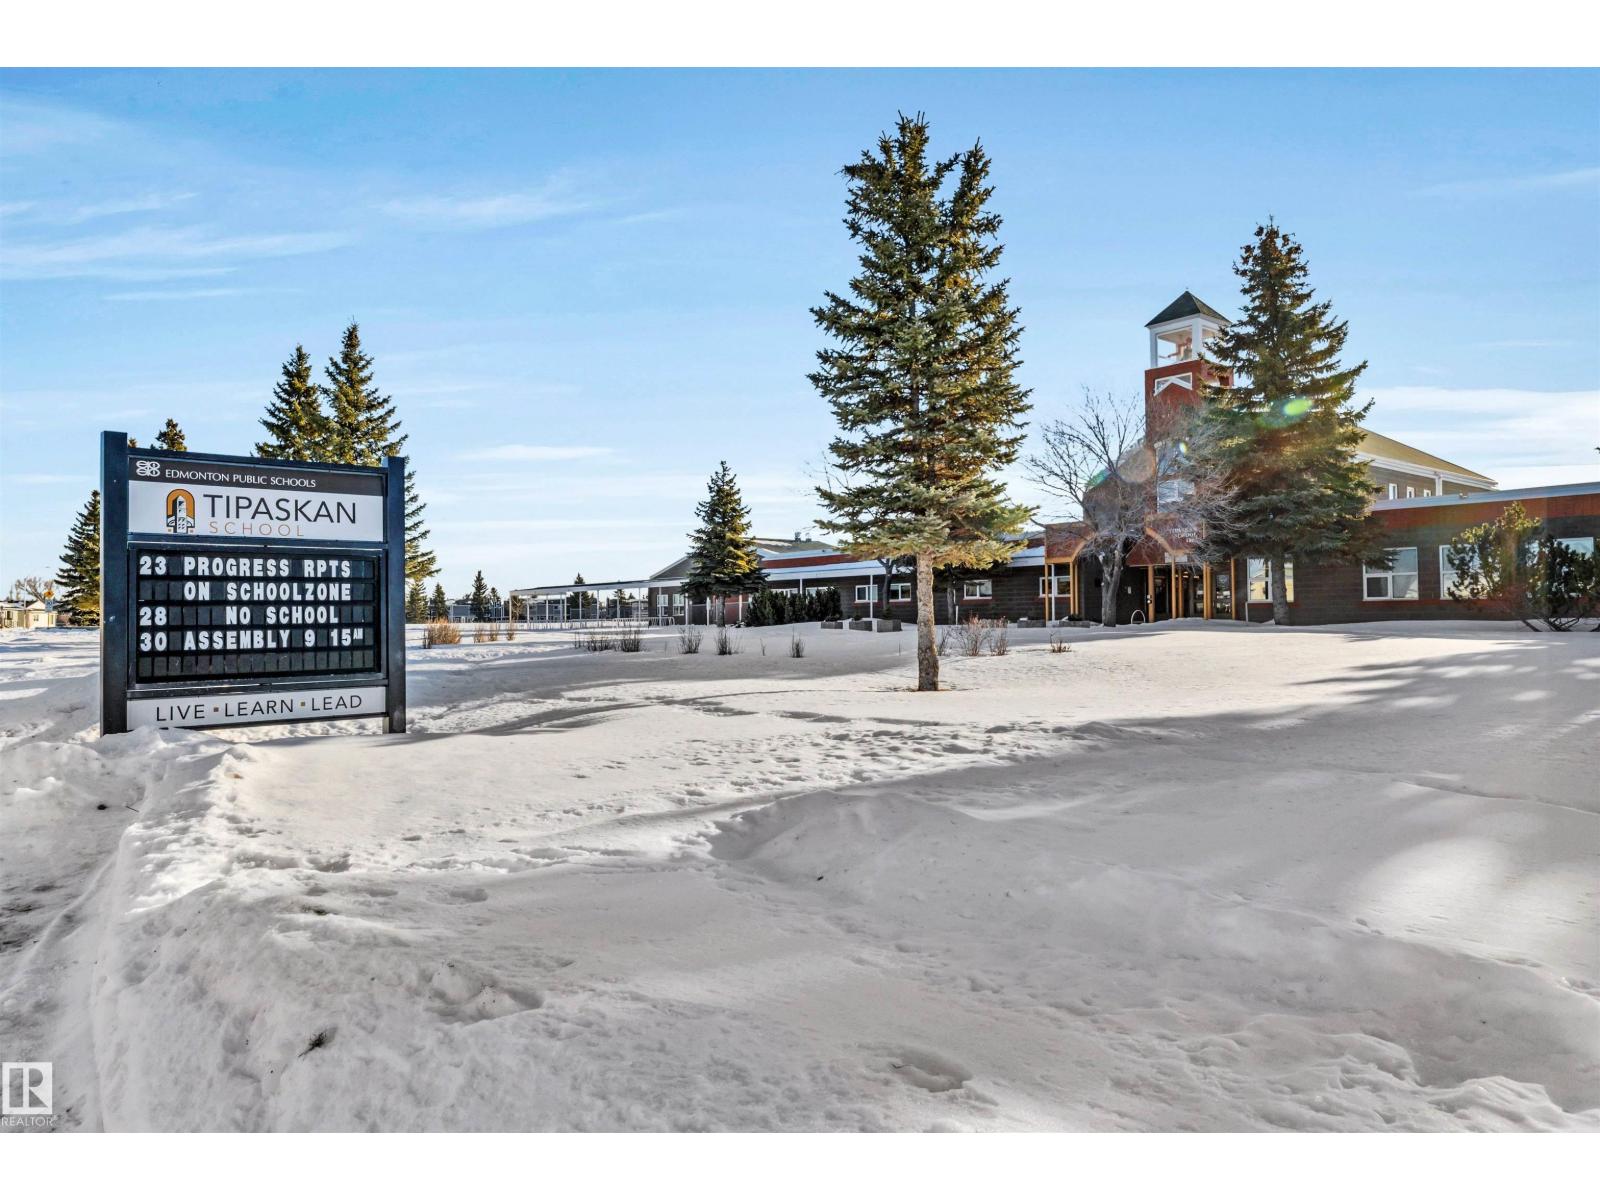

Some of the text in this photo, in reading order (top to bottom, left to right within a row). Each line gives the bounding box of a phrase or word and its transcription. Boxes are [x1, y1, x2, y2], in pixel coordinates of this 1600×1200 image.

[165, 469, 316, 488] EDMONTON PUBLIC SCHOOLS
[203, 493, 356, 524] TIPASKAN
[209, 521, 304, 537] SCHOOL
[139, 555, 351, 578] 23 PROGRESS RPTS
[184, 581, 351, 601] ON SCHOOLZONE
[139, 605, 339, 626] 28 NO SCHOOL
[139, 631, 167, 651] 30
[183, 629, 290, 651] ASSEMBLY
[304, 629, 315, 647] 9
[156, 694, 362, 722] LIVE LEARN LEAD
